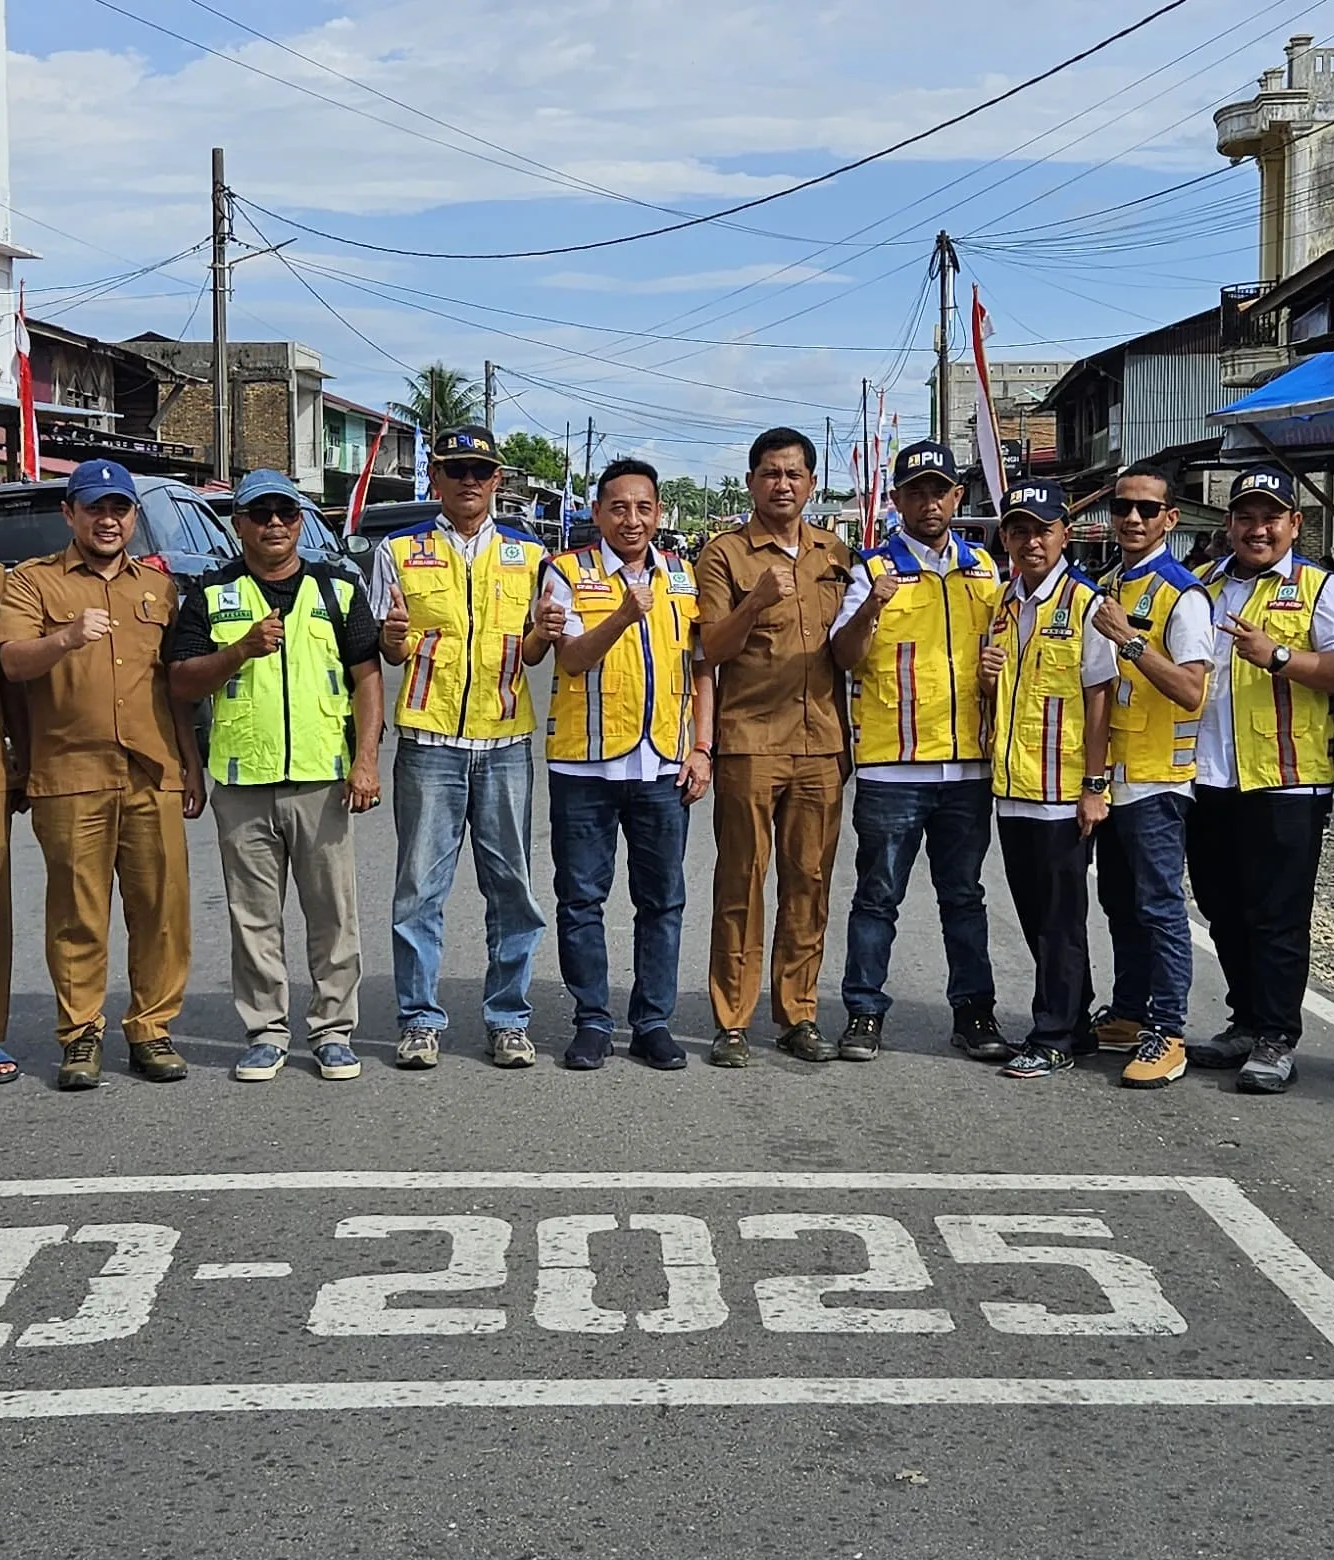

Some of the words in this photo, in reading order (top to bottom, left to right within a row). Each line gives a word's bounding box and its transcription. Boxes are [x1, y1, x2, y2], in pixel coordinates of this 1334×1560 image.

[921, 451, 944, 467] PU
[1254, 474, 1280, 490] PU
[1022, 487, 1048, 503] PU
